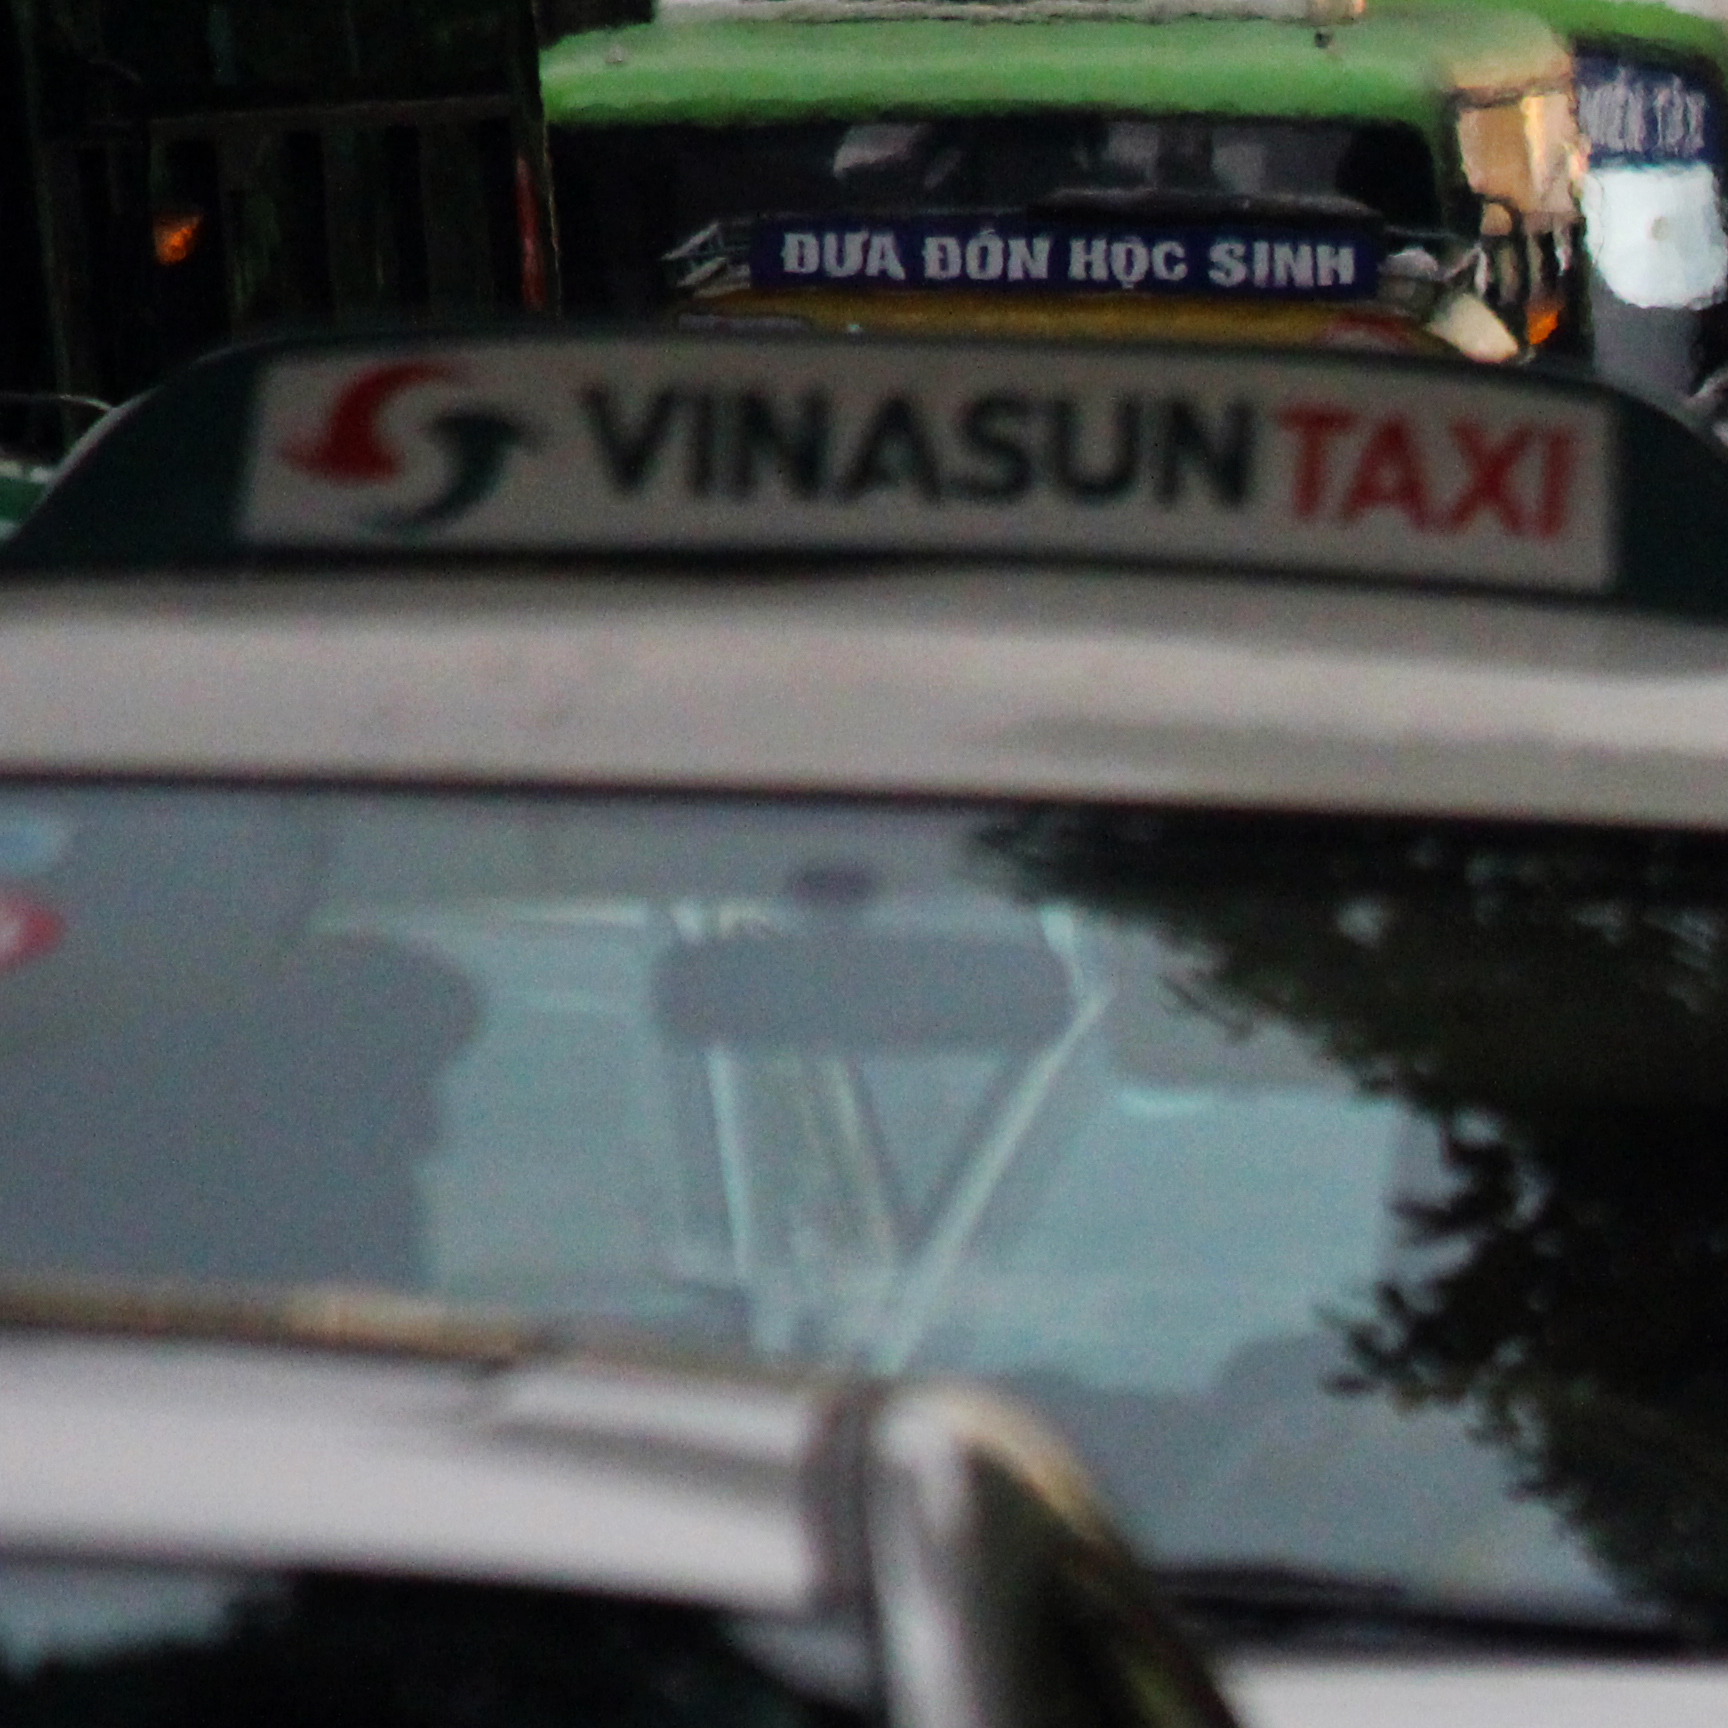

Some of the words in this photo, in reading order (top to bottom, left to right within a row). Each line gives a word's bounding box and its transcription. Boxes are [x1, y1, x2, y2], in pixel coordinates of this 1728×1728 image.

[781, 231, 906, 281] ĐƯA
[922, 230, 1050, 281] ĐÓN
[1067, 239, 1188, 289] HỌC
[1208, 241, 1356, 286] SINH
